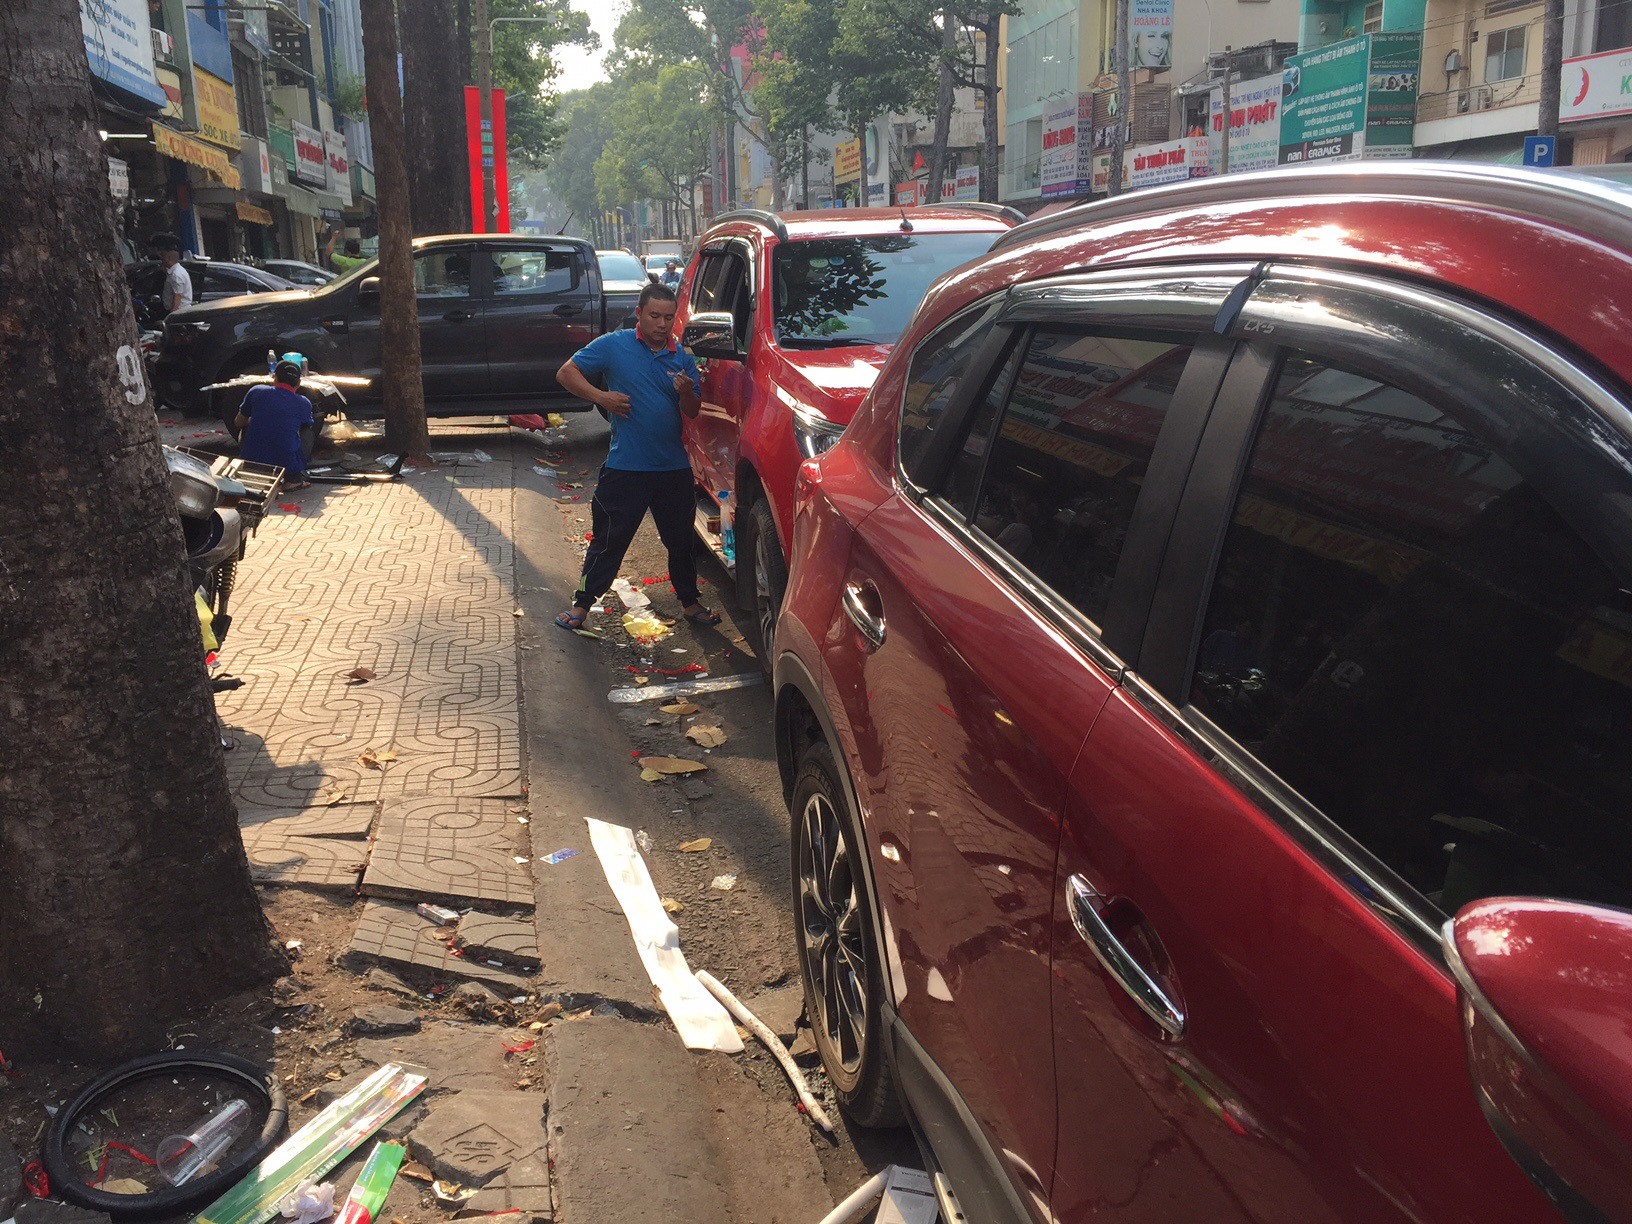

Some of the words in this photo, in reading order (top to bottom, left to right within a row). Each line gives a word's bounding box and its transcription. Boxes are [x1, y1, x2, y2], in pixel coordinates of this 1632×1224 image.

[1534, 144, 1548, 163] P
[1243, 320, 1276, 334] CX-5
[116, 344, 146, 405] 9
